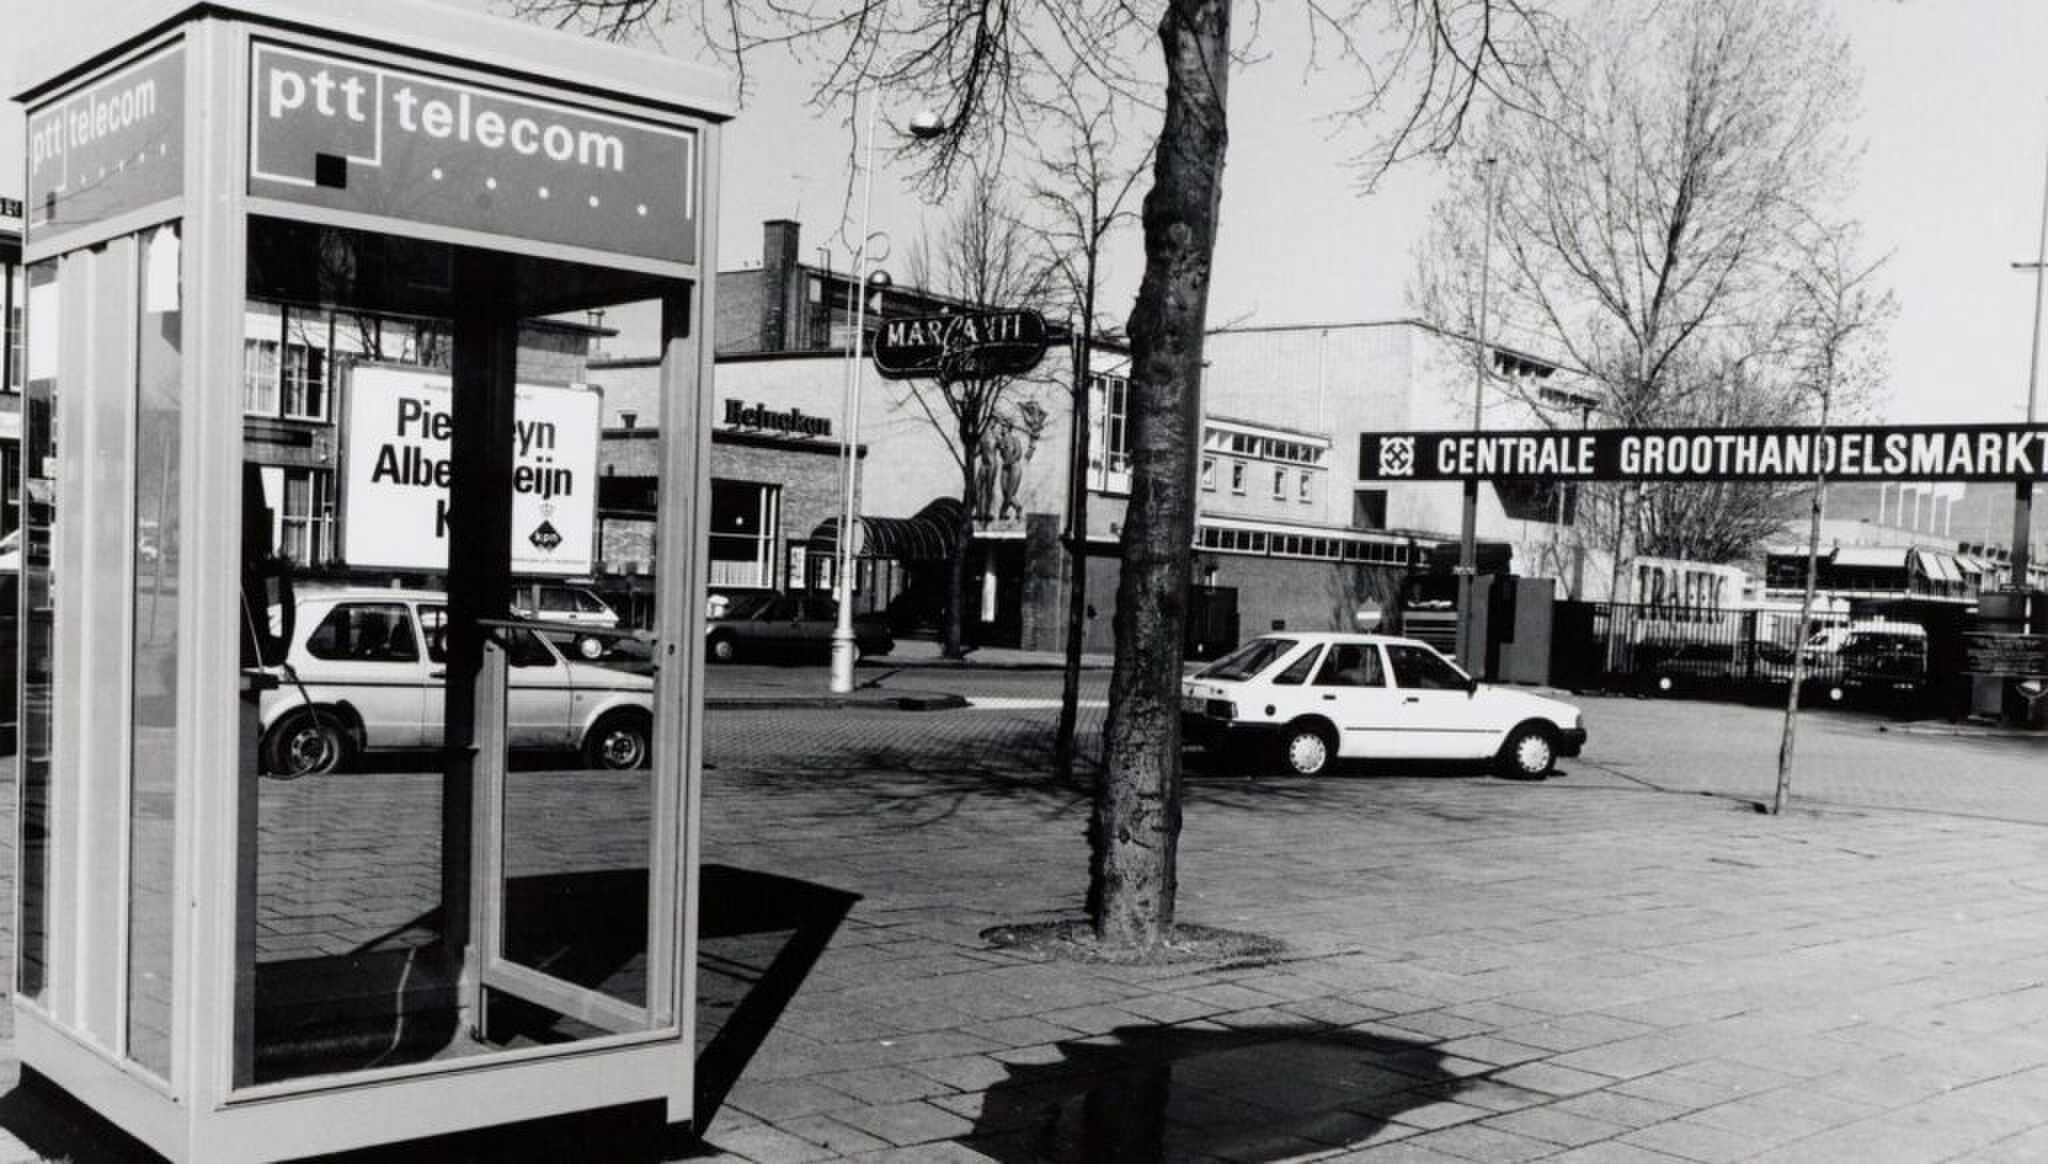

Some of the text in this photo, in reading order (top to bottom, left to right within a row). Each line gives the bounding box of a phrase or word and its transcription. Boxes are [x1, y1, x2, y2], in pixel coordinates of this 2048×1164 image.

[34, 79, 155, 176] ptt telecom
[269, 67, 624, 171] ptt telecom
[397, 397, 452, 441] Pie
[371, 443, 574, 500] Albe eijn
[1437, 432, 2048, 474] CENTRALE GROOTHANDELSMARKT
